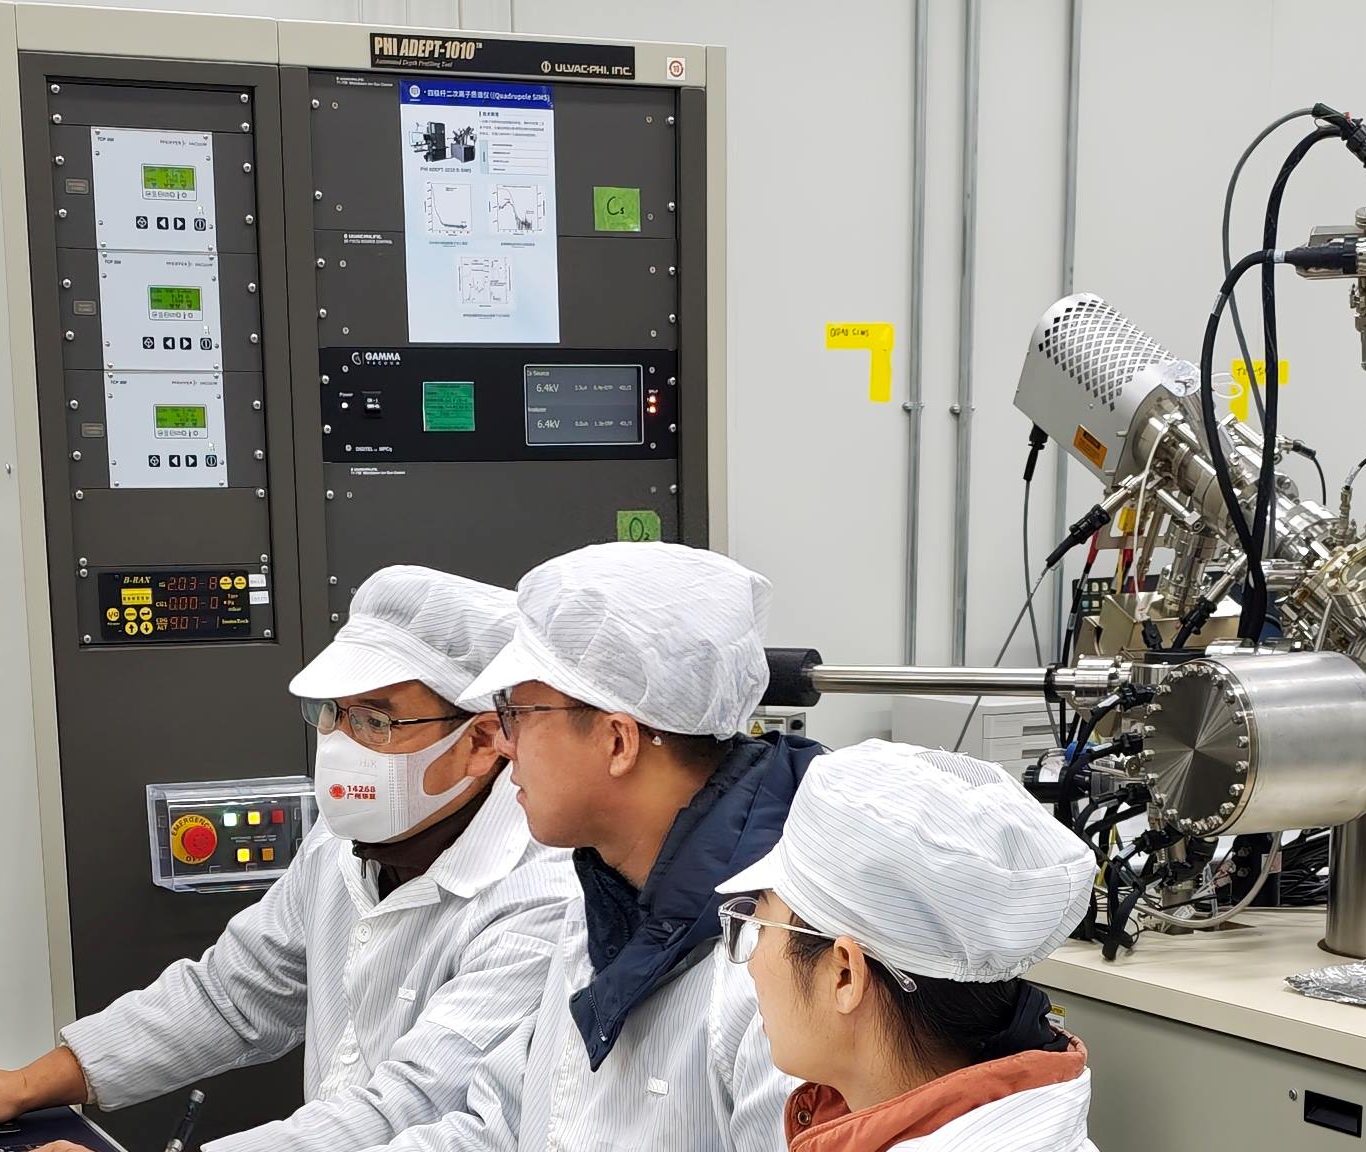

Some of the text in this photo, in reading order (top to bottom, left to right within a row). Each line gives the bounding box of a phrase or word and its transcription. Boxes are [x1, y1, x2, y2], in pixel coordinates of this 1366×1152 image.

[374, 36, 397, 56] PHI
[606, 196, 625, 216] Cs
[365, 351, 401, 361] GAMMA
[536, 383, 560, 393] 6.4kV
[537, 419, 561, 429] 6.4kV
[123, 576, 152, 584] B-RAX
